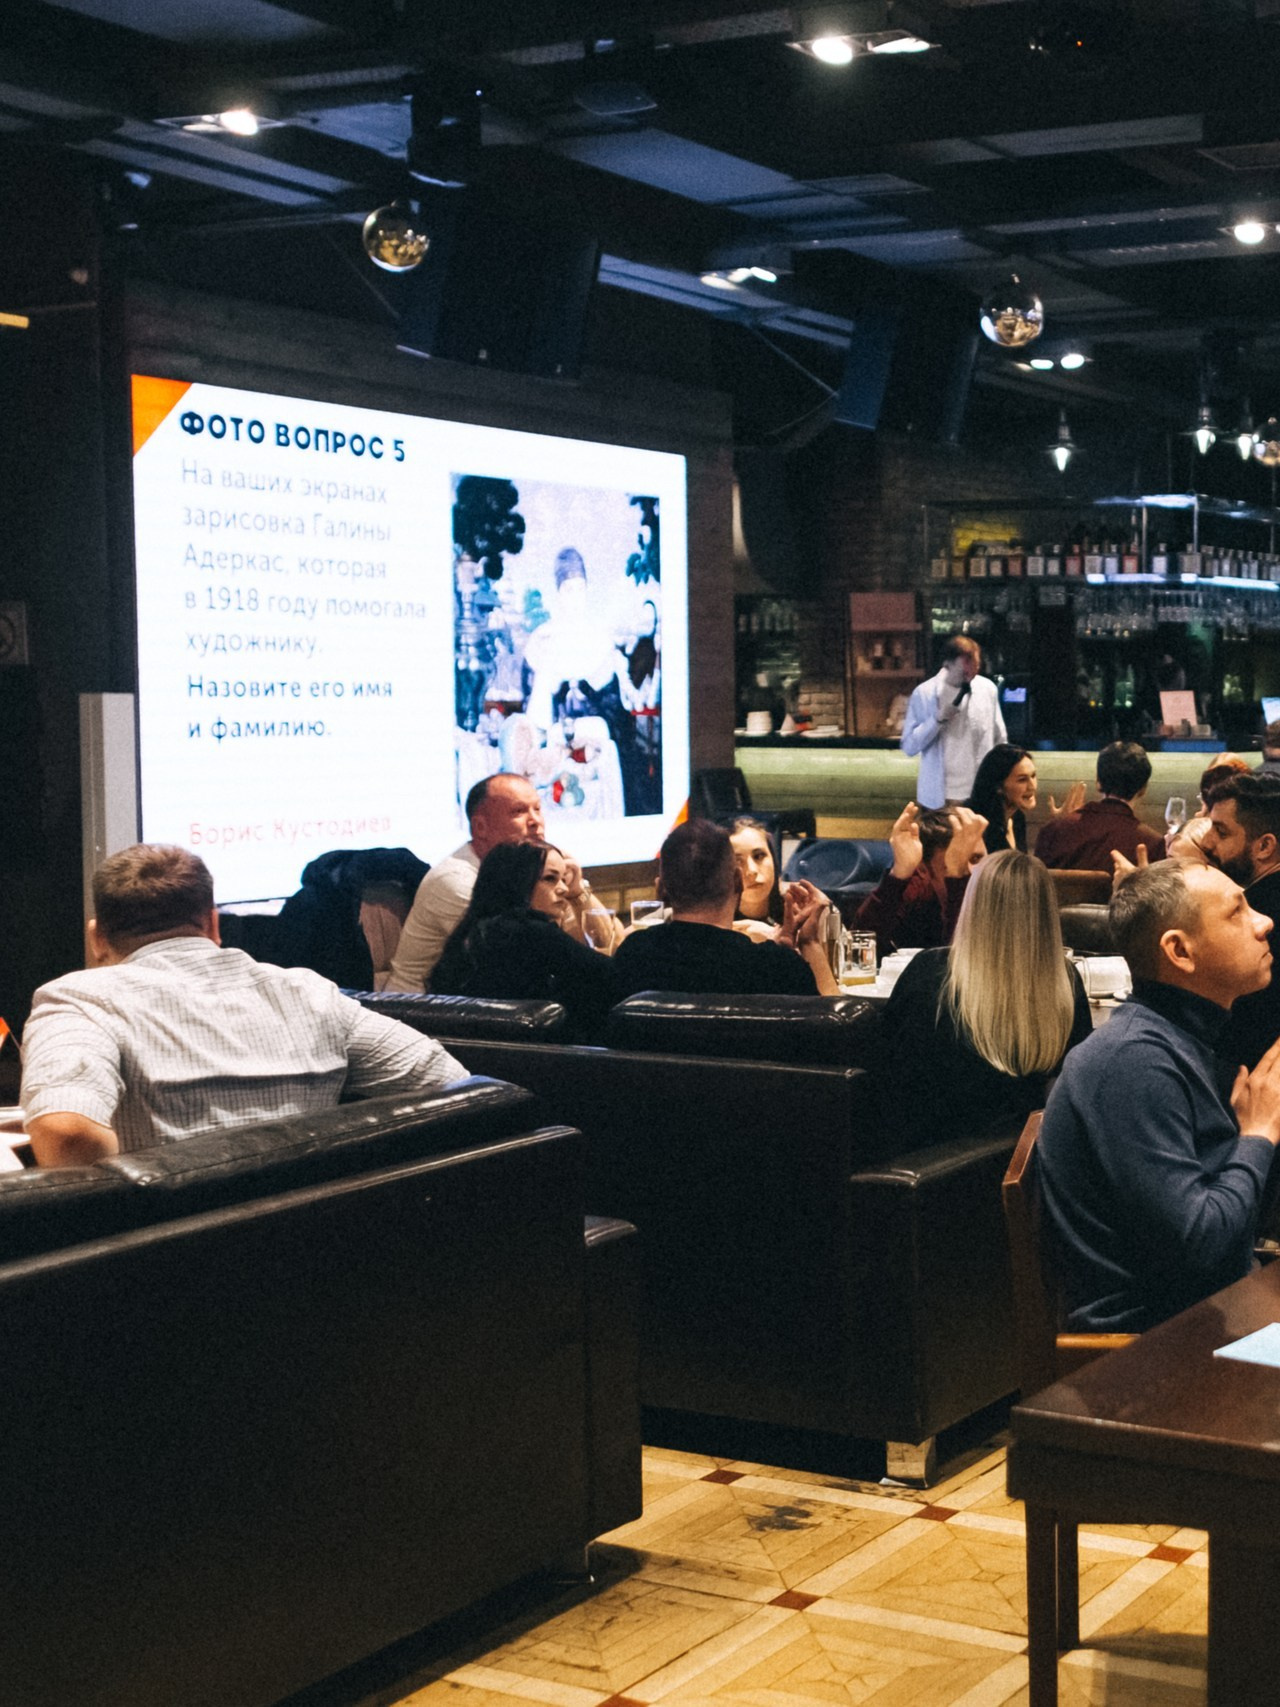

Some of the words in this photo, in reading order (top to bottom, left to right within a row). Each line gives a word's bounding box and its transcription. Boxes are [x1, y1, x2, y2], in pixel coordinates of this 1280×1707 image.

[180, 411, 265, 444] ФОТО
[275, 423, 384, 459] ВОПРОС
[393, 438, 406, 462] 5
[182, 459, 213, 485] На
[222, 471, 291, 492] ваших
[301, 479, 386, 503] экранах
[184, 507, 305, 534] зарисовка
[313, 512, 390, 541] Галины
[299, 558, 387, 583] которая
[184, 592, 196, 609] в
[207, 586, 258, 611] 1918
[268, 595, 317, 620] году
[327, 598, 427, 619] помогала
[188, 675, 301, 698] Назовите
[309, 682, 344, 698] его
[353, 683, 392, 696] имя
[189, 724, 200, 737] и
[210, 716, 333, 744] фамилию.
[190, 822, 264, 850] Борис
[273, 816, 391, 845] Кустодиев
